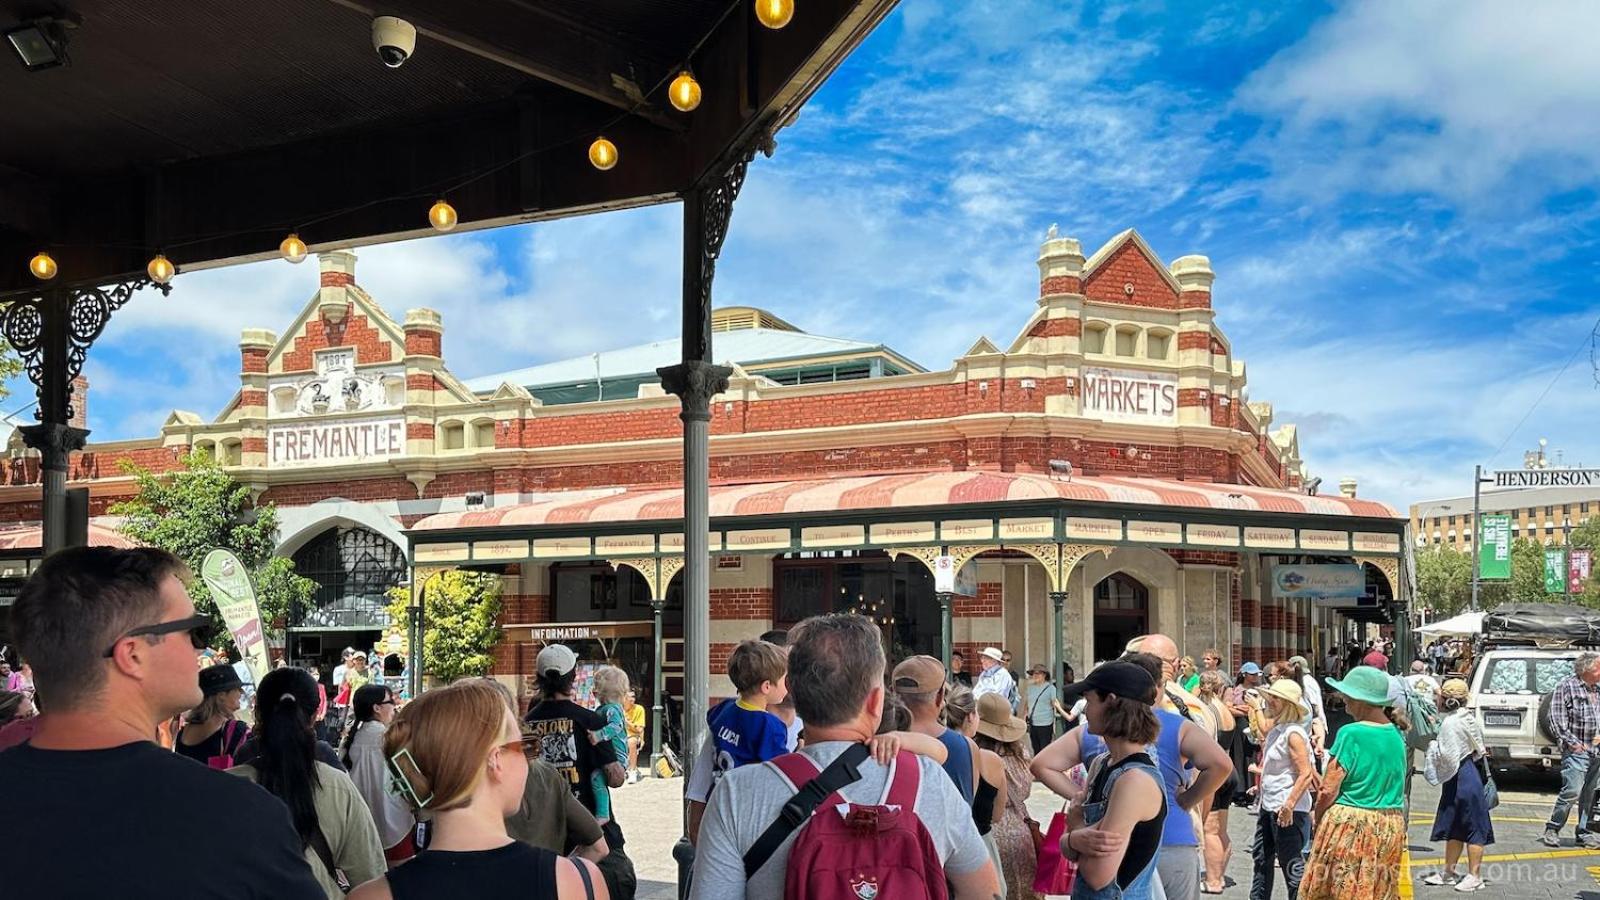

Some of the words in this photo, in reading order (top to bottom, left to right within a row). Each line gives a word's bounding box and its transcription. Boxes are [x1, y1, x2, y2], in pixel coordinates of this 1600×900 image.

[1082, 374, 1174, 416] MARKETS
[272, 423, 401, 462] FREMANTLE
[1496, 471, 1592, 486] HENDERSON
[1196, 529, 1229, 540] FRIDAY
[1247, 533, 1291, 542] SATURDAY
[1308, 535, 1339, 544] SUNDAY
[531, 627, 590, 640] INFORMATION
[718, 726, 741, 747] LUCA
